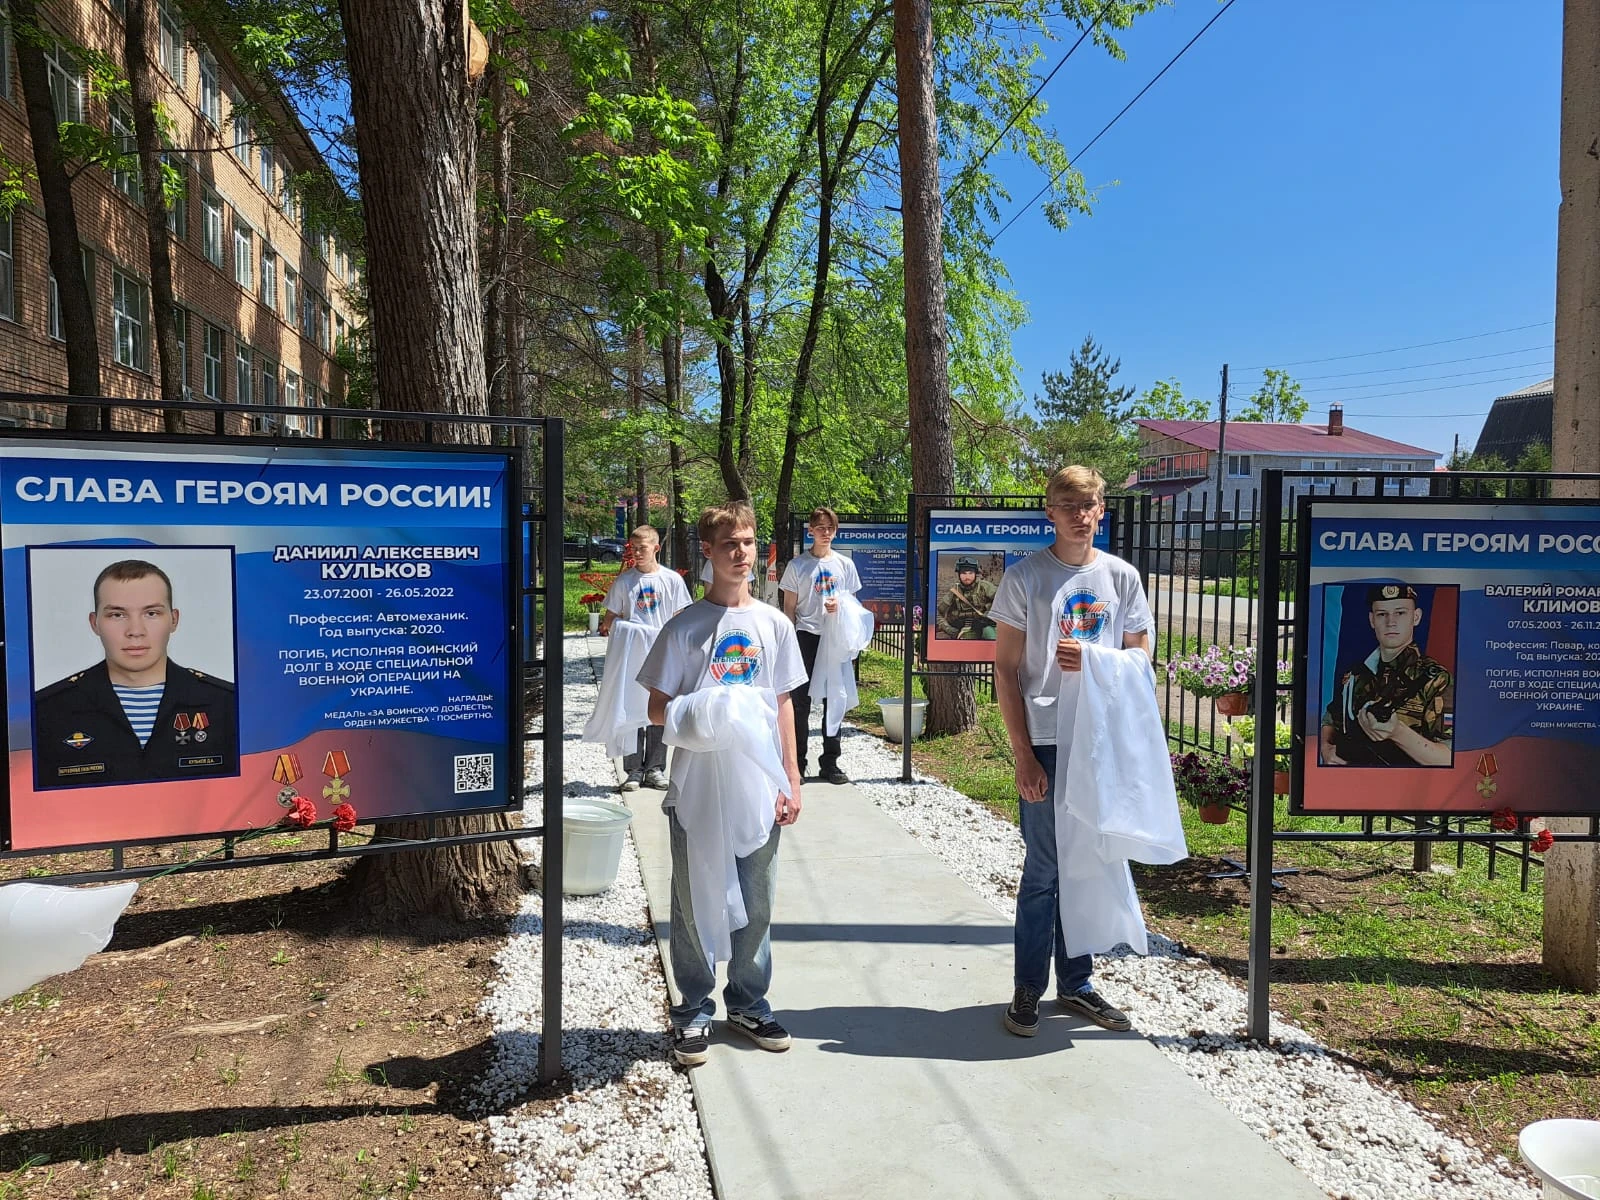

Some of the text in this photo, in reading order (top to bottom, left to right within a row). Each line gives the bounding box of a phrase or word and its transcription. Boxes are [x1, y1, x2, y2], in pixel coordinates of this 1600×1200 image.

[15, 476, 492, 509] СЛАВА ГЕРОЯМ РОССИИ!
[840, 532, 876, 540] ГЕРОЯМ
[935, 523, 982, 535] СЛАВА
[986, 524, 1040, 536] ГЕРОЯМ
[1319, 531, 1414, 552] СЛАВА
[1423, 532, 1529, 553] ГЕРОЯМ
[274, 545, 480, 562] ДАНИИЛ АЛЕКСЕЕВИЧ
[321, 562, 433, 580] КУЛЬКОВ
[303, 588, 374, 600] 23.07.2001
[385, 587, 454, 598] 26.05.2022
[1485, 583, 1552, 597] ВАЛЕРИЙ
[1523, 599, 1600, 614] КЛИМОВ
[288, 611, 469, 627] Профессия: Автомеханик.
[1507, 620, 1562, 630] 07.05.2003
[319, 625, 445, 639] Год выпуска: 2020.
[278, 642, 479, 661] ПОГИБ, ИСПОЛНЯЯ ВОИНСКИЙ
[1485, 640, 1548, 651] Профессия:
[1550, 640, 1585, 651] Повар,
[1516, 651, 1533, 662] Год
[1536, 653, 1583, 663] выпуска:
[284, 656, 474, 675] ДОЛГ В ХОДЕ СПЕЦИАЛЬНОЙ
[299, 670, 462, 687] ВОЕННОЙ ОПЕРАЦИИ НА
[1485, 669, 1522, 679] ПОГИБ,
[1525, 669, 1580, 678] ИСПОЛНЯЯ
[350, 685, 414, 698] УКРАИНЕ.
[1488, 680, 1600, 690] ДОЛГ В ХОДЕ СПЕЦИА
[448, 694, 494, 704] НАГРАДЫ:
[1499, 690, 1600, 702] ВОЕННОЙ ОПЕРАЦИ
[324, 710, 366, 720] МЕДАЛЬ
[368, 709, 385, 718] «ЗА
[386, 706, 440, 717] ВОИНСКУЮ
[1535, 702, 1585, 711] УКРАИНЕ.
[343, 718, 376, 728] ОРДЕН
[378, 715, 430, 726] МУЖЕСТВА
[437, 712, 494, 723] ПОСМЕРТНО.
[1530, 721, 1555, 729] ОРДЕН
[1556, 721, 1596, 729] МУЖЕСТВА
